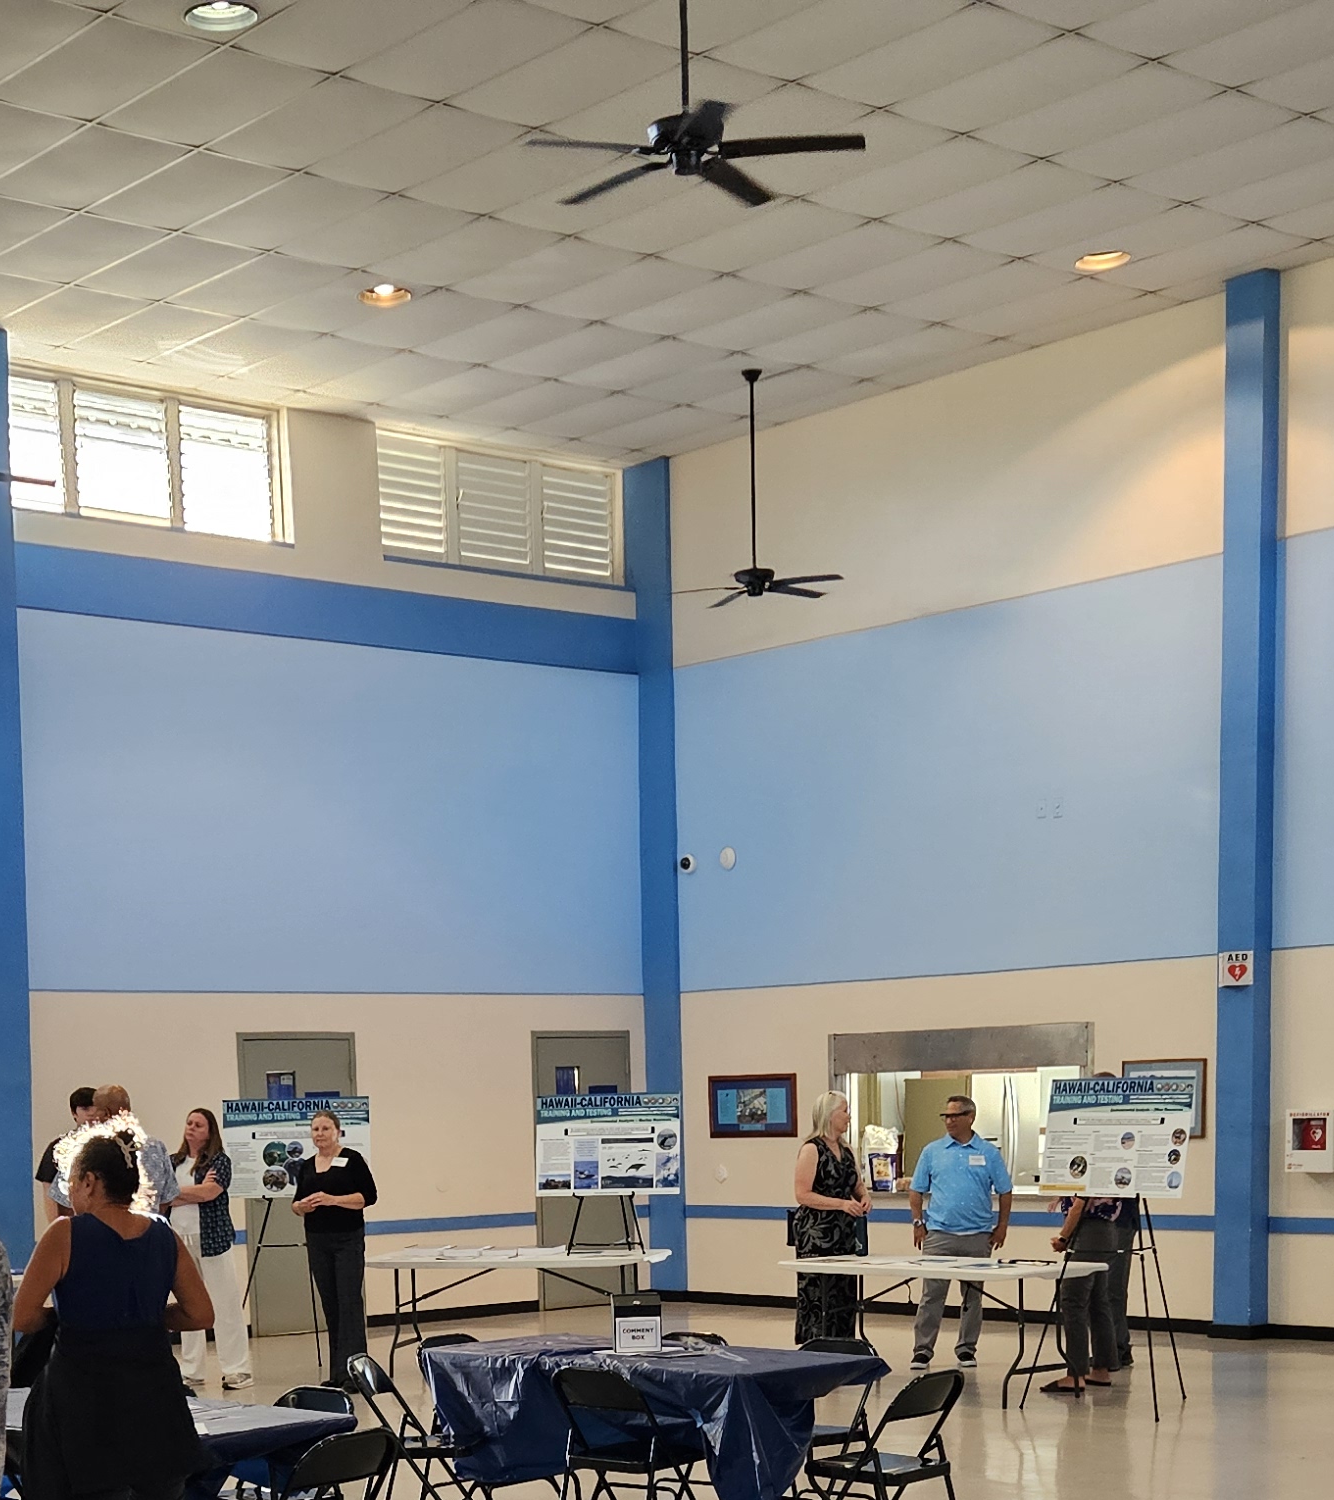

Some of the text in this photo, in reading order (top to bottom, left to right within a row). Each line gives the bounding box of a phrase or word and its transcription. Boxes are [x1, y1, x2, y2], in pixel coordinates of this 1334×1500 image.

[1227, 953, 1248, 962] AED
[1054, 1080, 1155, 1095] HAWAII-CALIFORNIA
[541, 1095, 642, 1109] HAWAII-CALIFORNIA
[1052, 1096, 1082, 1105] TRAINING
[1082, 1095, 1097, 1104] AND
[1097, 1094, 1124, 1104] TESTING
[226, 1099, 331, 1113] HAWAII-CALIFORNIA
[226, 1113, 257, 1122] TRAINING
[258, 1112, 273, 1121] AND
[273, 1112, 301, 1121] TESTING
[540, 1109, 570, 1118] TRAINING
[571, 1108, 586, 1117] AND
[586, 1108, 612, 1117] TESTING
